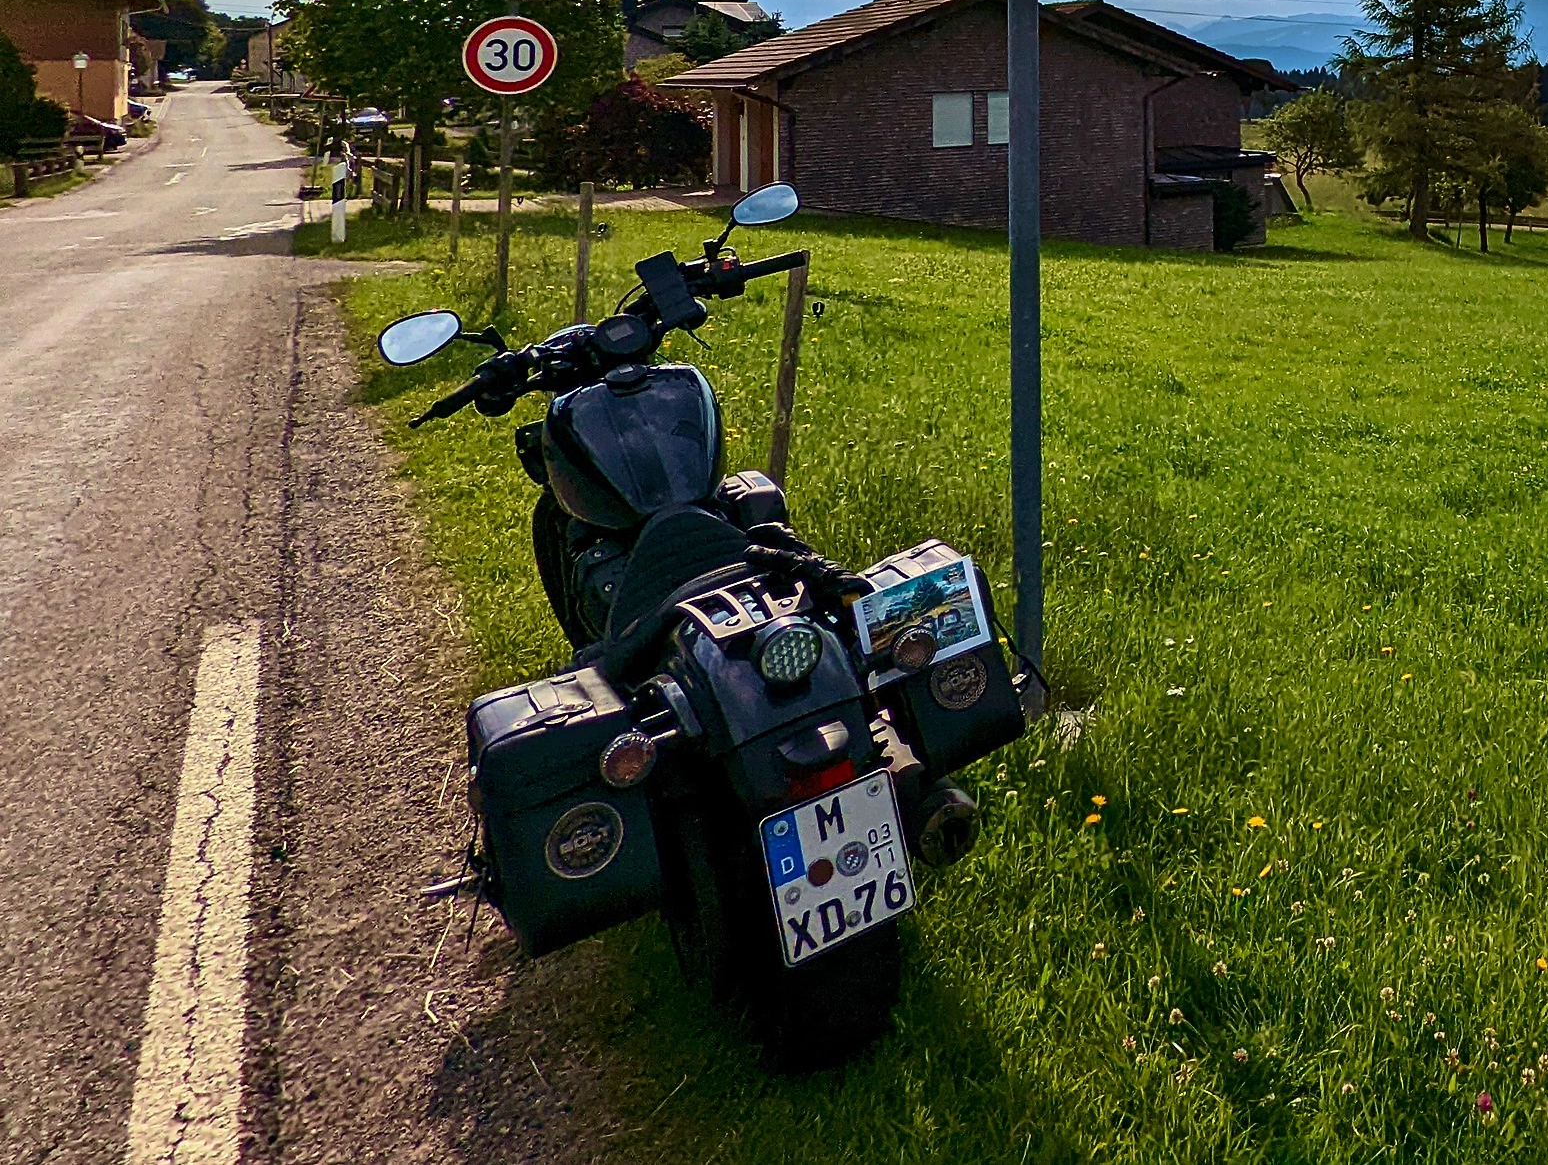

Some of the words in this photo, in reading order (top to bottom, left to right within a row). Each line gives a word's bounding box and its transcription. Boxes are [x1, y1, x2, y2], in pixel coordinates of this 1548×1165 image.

[484, 39, 536, 71] 30
[814, 796, 845, 842] M
[868, 823, 891, 845] 03
[780, 856, 795, 875] D
[874, 847, 895, 868] 11
[788, 897, 847, 959] XD
[853, 869, 908, 924] 76
